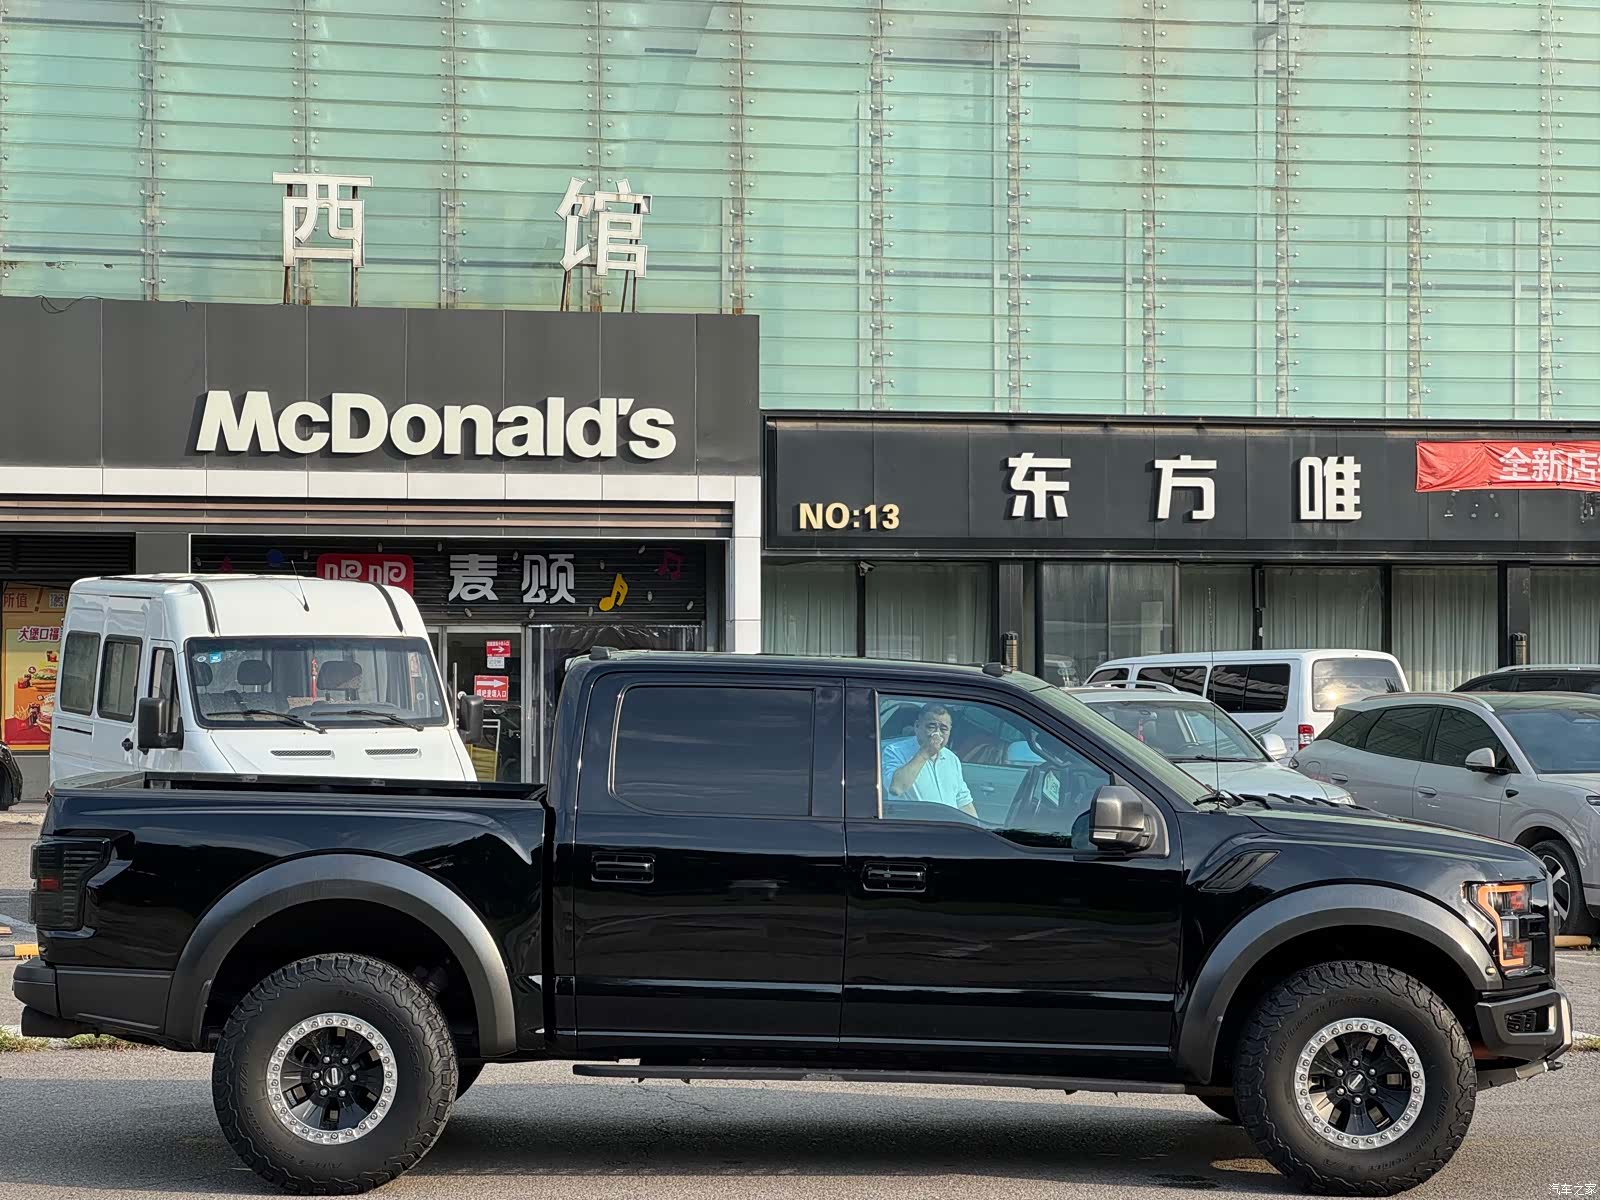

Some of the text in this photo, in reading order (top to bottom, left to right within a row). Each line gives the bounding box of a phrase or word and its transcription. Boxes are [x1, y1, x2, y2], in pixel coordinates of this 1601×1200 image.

[272, 172, 652, 278] 西馆
[195, 389, 677, 459] McDonald's
[1008, 452, 1362, 520] 东方唯
[1499, 447, 1600, 483] 全新店
[799, 502, 900, 530] NO:13
[448, 553, 576, 605] 麦颂
